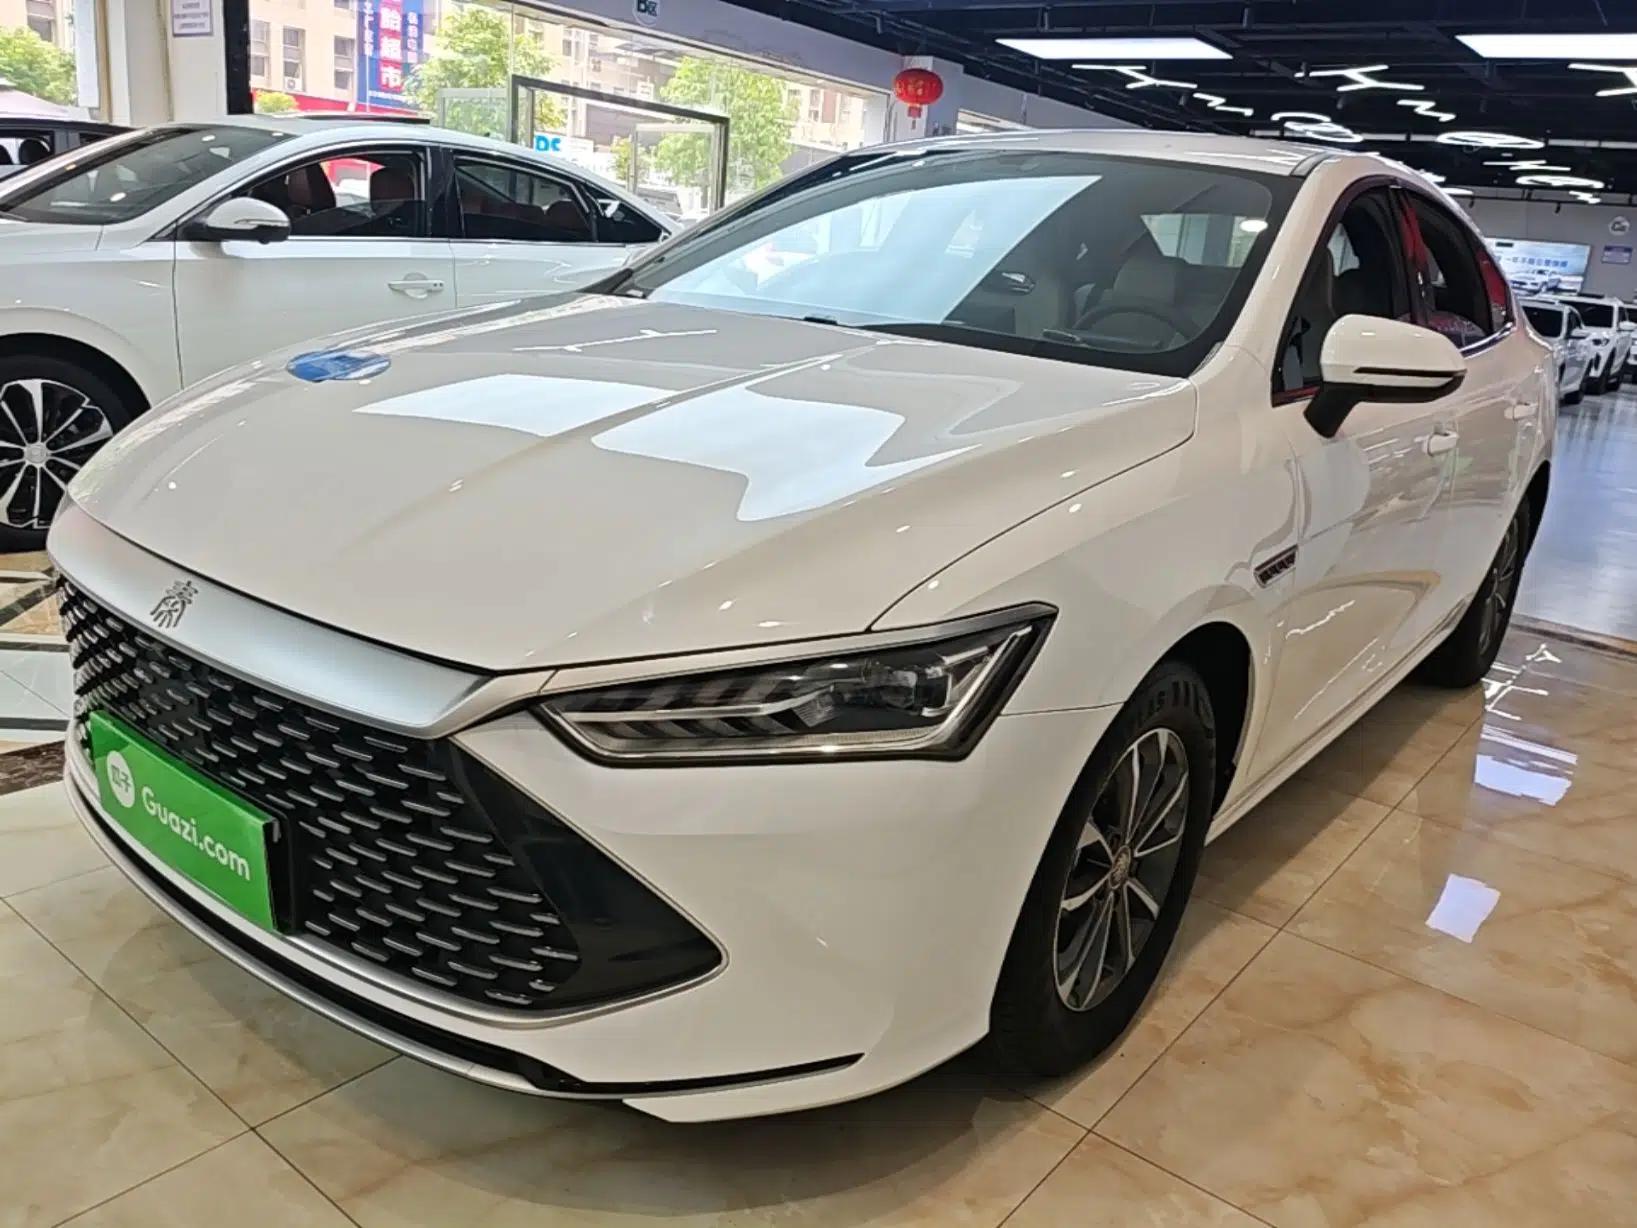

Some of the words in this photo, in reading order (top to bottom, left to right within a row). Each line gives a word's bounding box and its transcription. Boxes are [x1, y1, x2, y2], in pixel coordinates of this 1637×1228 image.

[380, 0, 402, 88] 胎超市
[142, 786, 251, 881] Guazi.com
